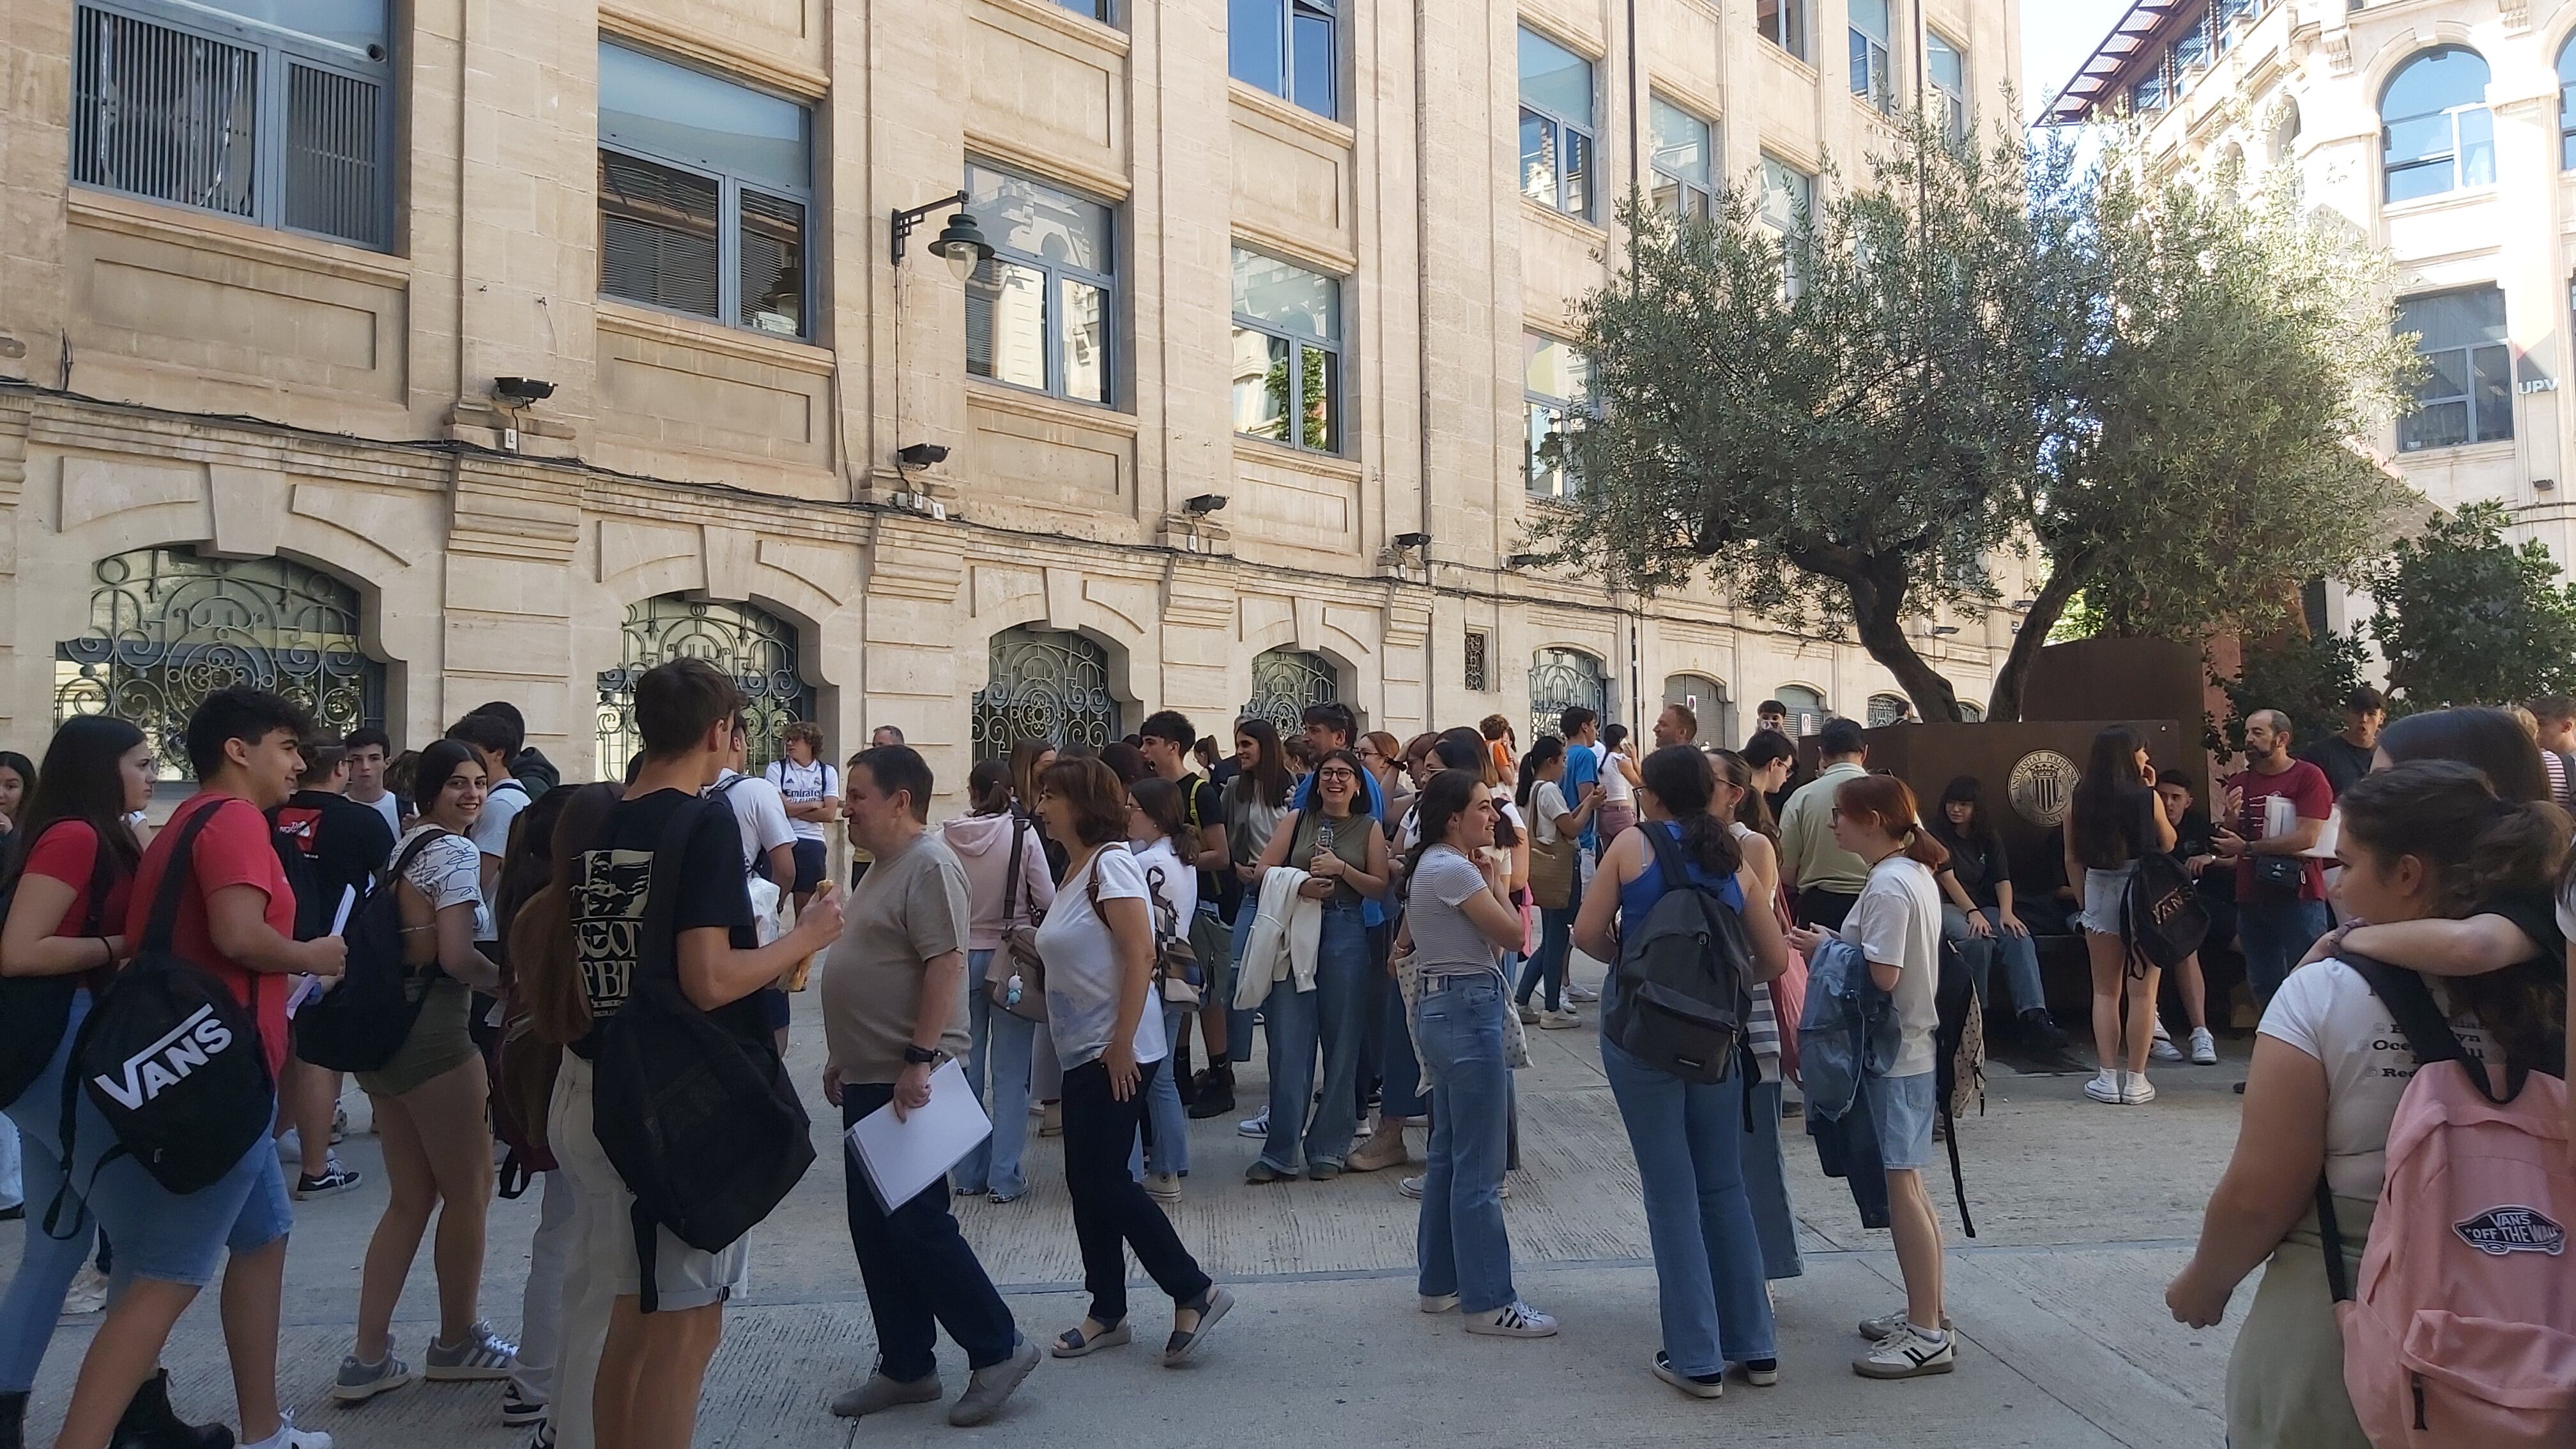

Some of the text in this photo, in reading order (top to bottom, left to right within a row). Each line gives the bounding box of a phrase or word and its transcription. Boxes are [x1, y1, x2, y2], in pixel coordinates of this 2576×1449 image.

[2518, 378, 2559, 395] UPV
[785, 788, 821, 798] Emirates
[2152, 885, 2193, 924] VANS
[93, 1002, 233, 1110] VANS
[2488, 1212, 2531, 1227] VANS
[2499, 1225, 2533, 1243] THE
